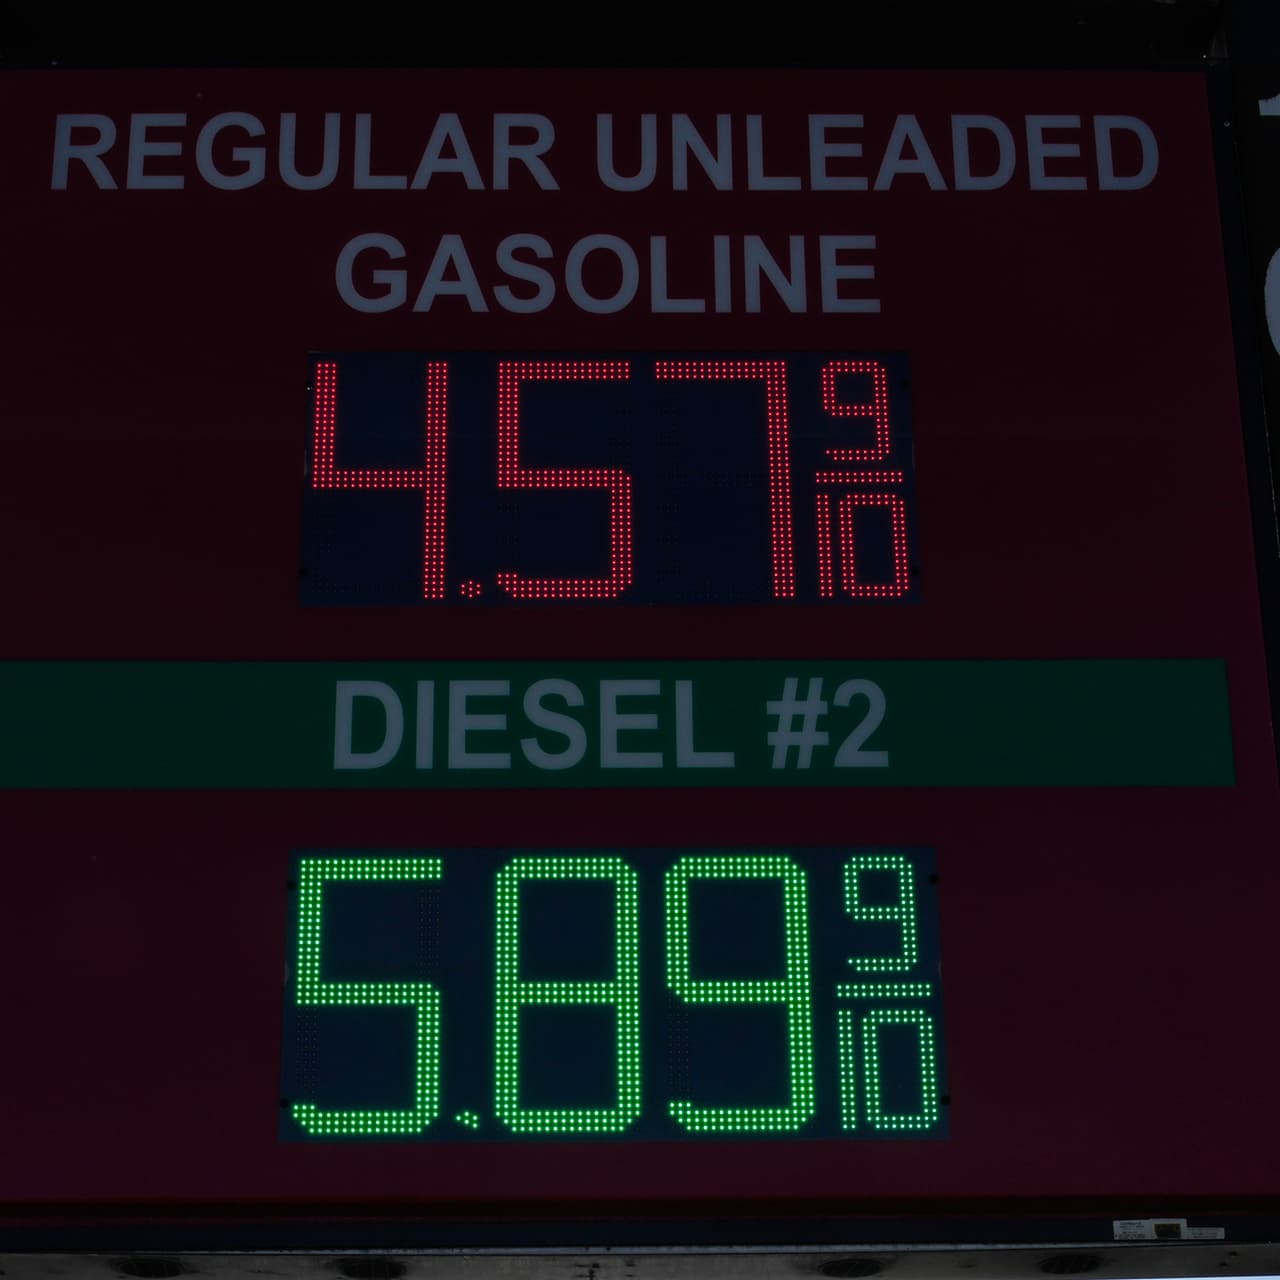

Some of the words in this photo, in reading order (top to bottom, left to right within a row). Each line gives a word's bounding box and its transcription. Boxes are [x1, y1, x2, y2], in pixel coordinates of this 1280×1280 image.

[51, 111, 560, 191] REGULAR
[596, 114, 1159, 192] UNLEADED
[335, 232, 881, 314] GASOLINE
[312, 361, 795, 599] 4.57
[334, 678, 734, 769] DIESEL
[767, 678, 886, 768] #2
[292, 856, 815, 1134] 5.89
